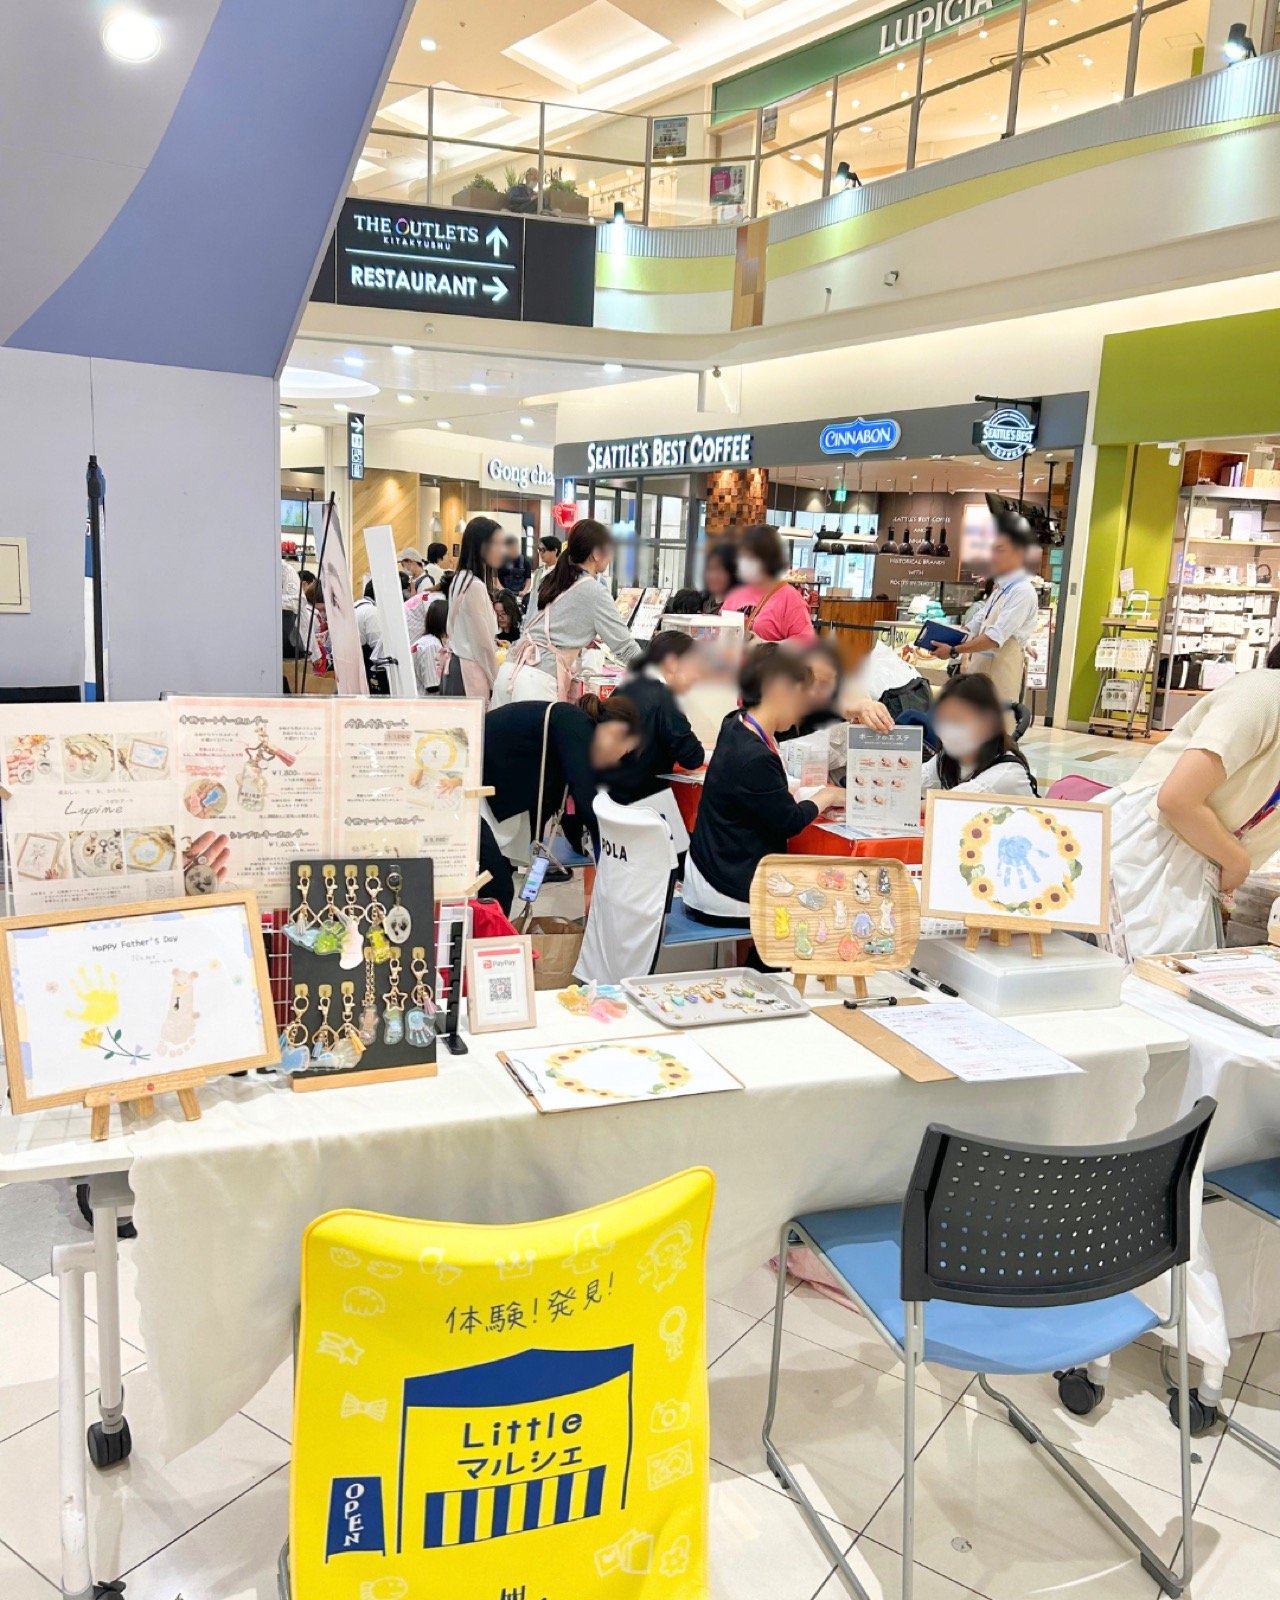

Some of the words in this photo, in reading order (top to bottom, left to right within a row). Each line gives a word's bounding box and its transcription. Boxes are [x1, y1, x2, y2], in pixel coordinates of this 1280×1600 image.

[353, 214, 391, 233] THE
[395, 216, 479, 243] OUTLETS
[383, 236, 451, 251] KITAKYUSHU
[351, 265, 478, 296] RESTAURANT
[824, 426, 892, 448] CINNABON
[983, 426, 1016, 441] SEATTLE'S
[1016, 429, 1033, 443] BEST
[587, 439, 649, 473] SEATTLE'S
[652, 437, 687, 466] BEST
[689, 433, 752, 463] COFFEE
[487, 458, 529, 487] Gong
[530, 462, 554, 486] cha
[92, 942, 117, 953] Happy
[121, 936, 160, 950] Father's
[163, 935, 179, 944] Day
[492, 958, 517, 969] PayPay
[462, 1409, 584, 1449] Little
[455, 1444, 584, 1481] マルシェ
[342, 1482, 366, 1547] OPEN
